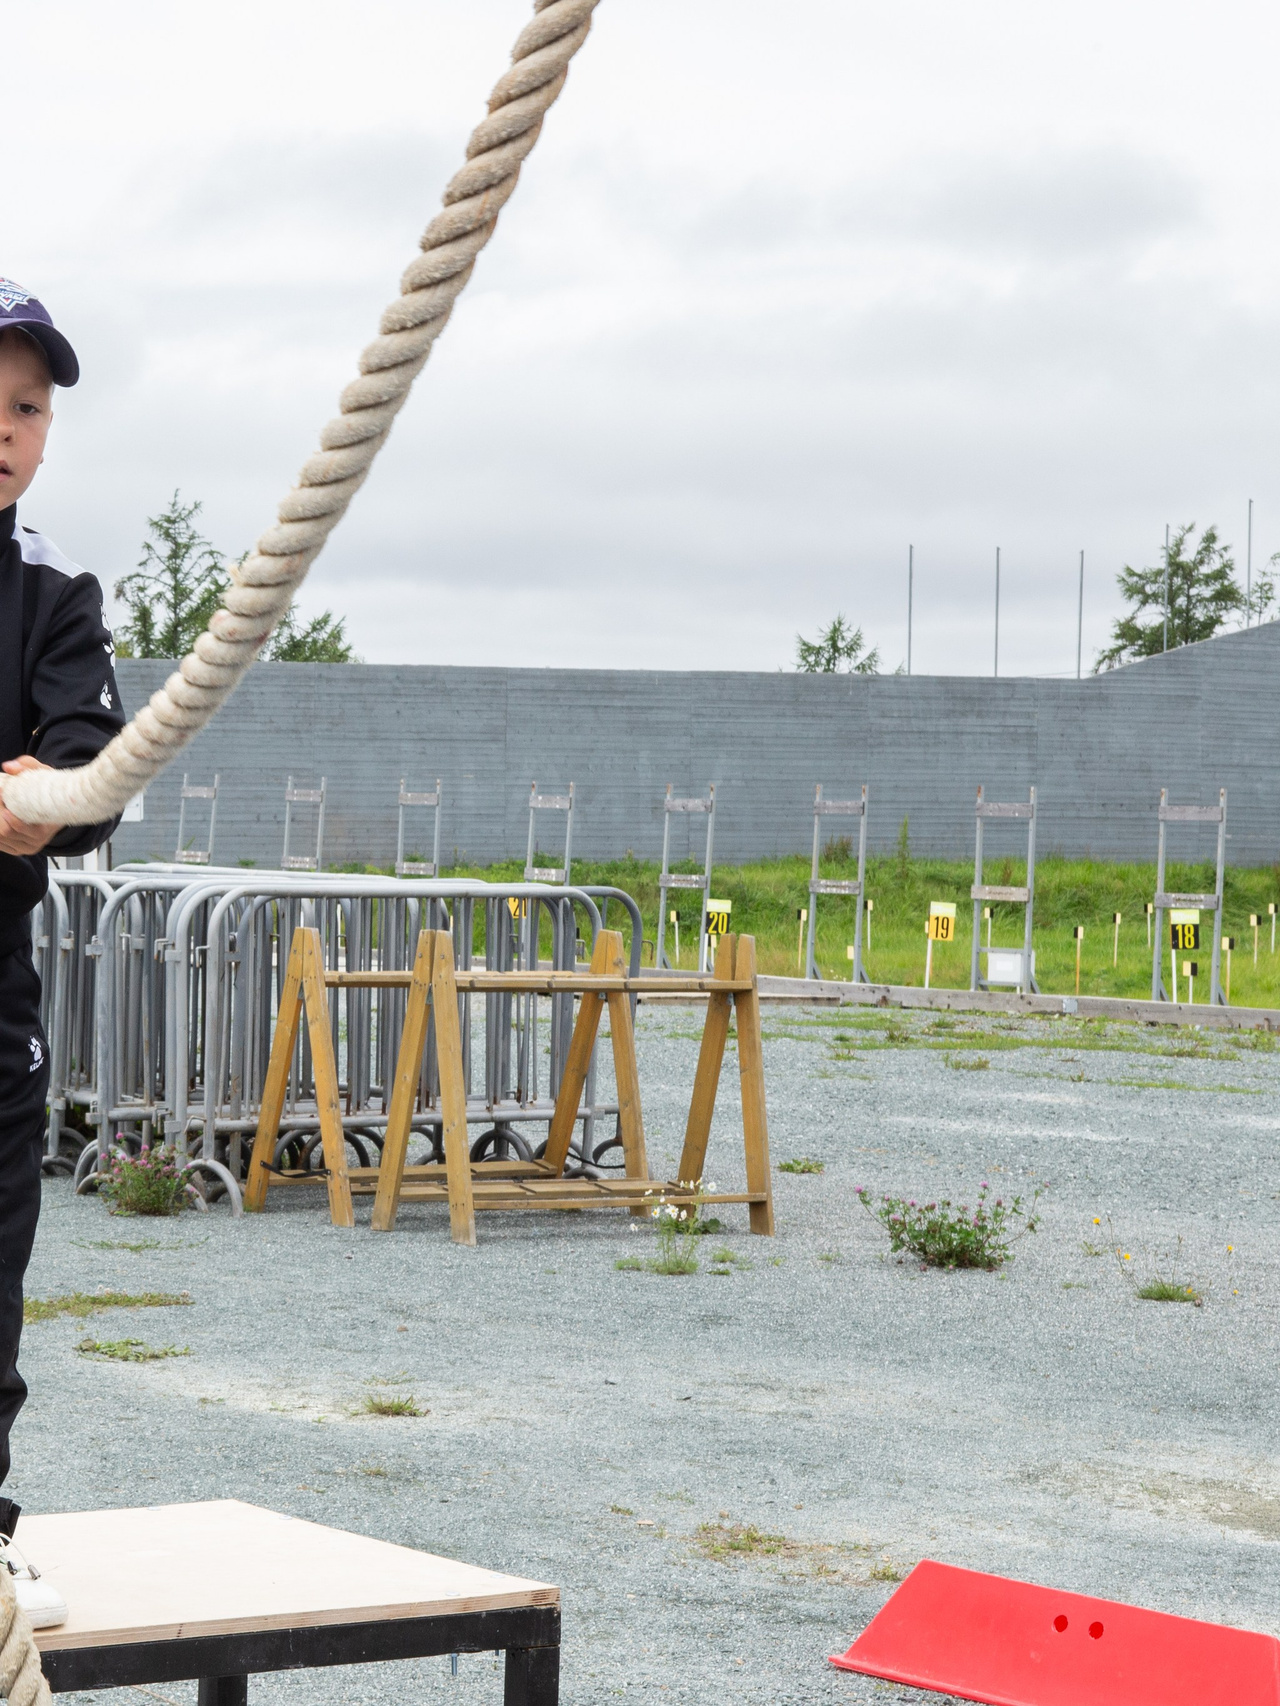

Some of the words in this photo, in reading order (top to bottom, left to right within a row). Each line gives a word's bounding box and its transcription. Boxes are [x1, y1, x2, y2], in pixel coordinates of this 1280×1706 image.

[708, 912, 728, 934] 20
[934, 916, 950, 939] 19
[1176, 924, 1195, 949] 18
